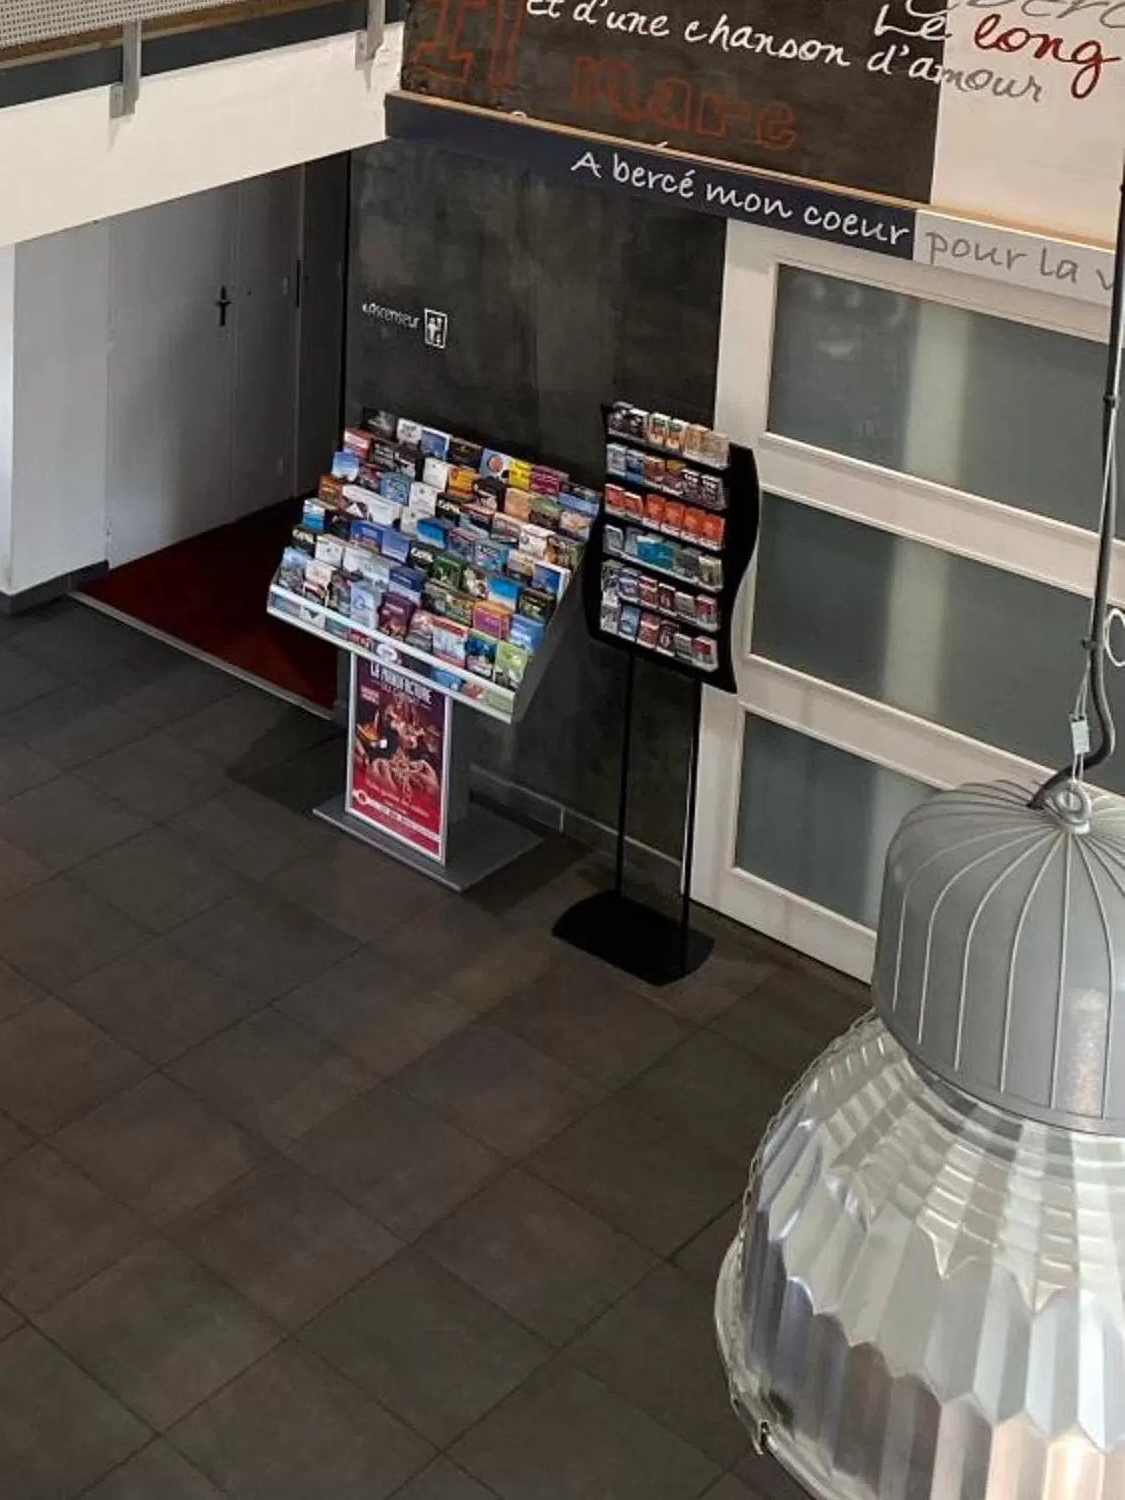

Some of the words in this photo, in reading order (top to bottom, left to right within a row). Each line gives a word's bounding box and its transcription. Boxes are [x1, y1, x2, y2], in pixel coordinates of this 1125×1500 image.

[684, 13, 851, 68] chanson
[867, 44, 1044, 103] d'amour
[974, 13, 1122, 99] long
[613, 153, 697, 198] bercé
[706, 183, 794, 219] mon
[804, 206, 910, 246] coeur
[926, 231, 1029, 271] pour
